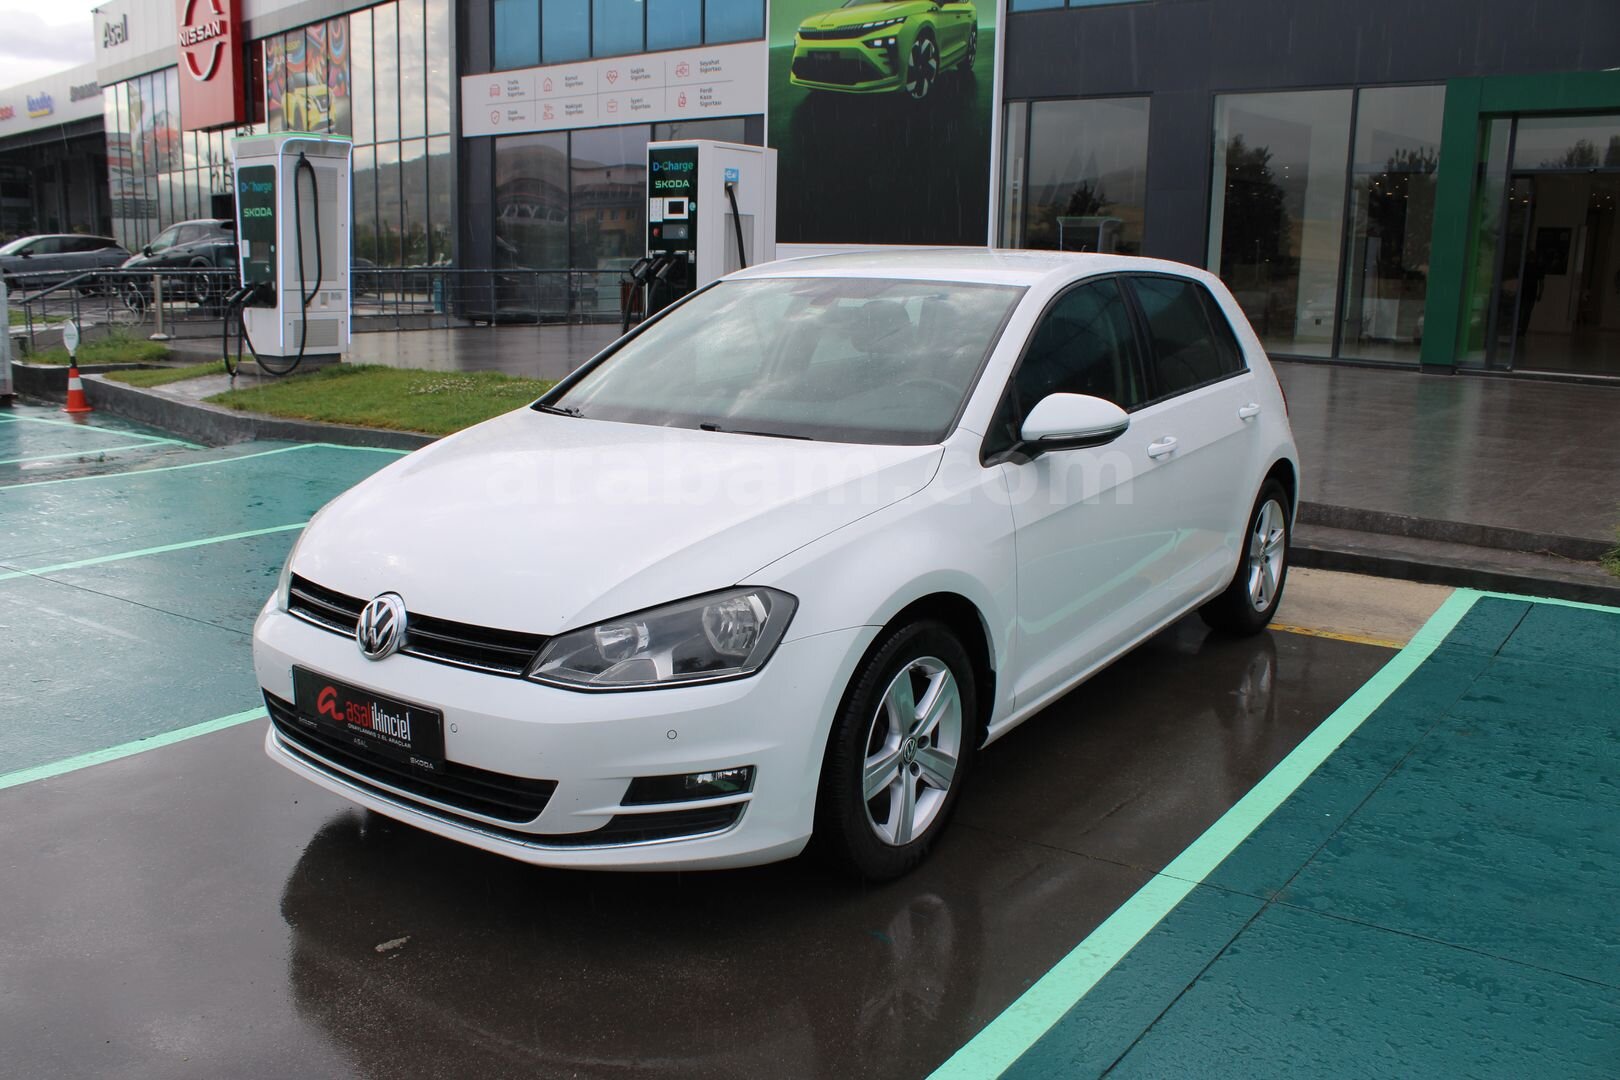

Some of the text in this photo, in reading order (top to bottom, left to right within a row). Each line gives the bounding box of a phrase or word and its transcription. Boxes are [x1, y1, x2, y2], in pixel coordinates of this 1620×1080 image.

[103, 13, 128, 48] Asal
[178, 20, 222, 47] NISSAN
[653, 161, 694, 173] D-Charge
